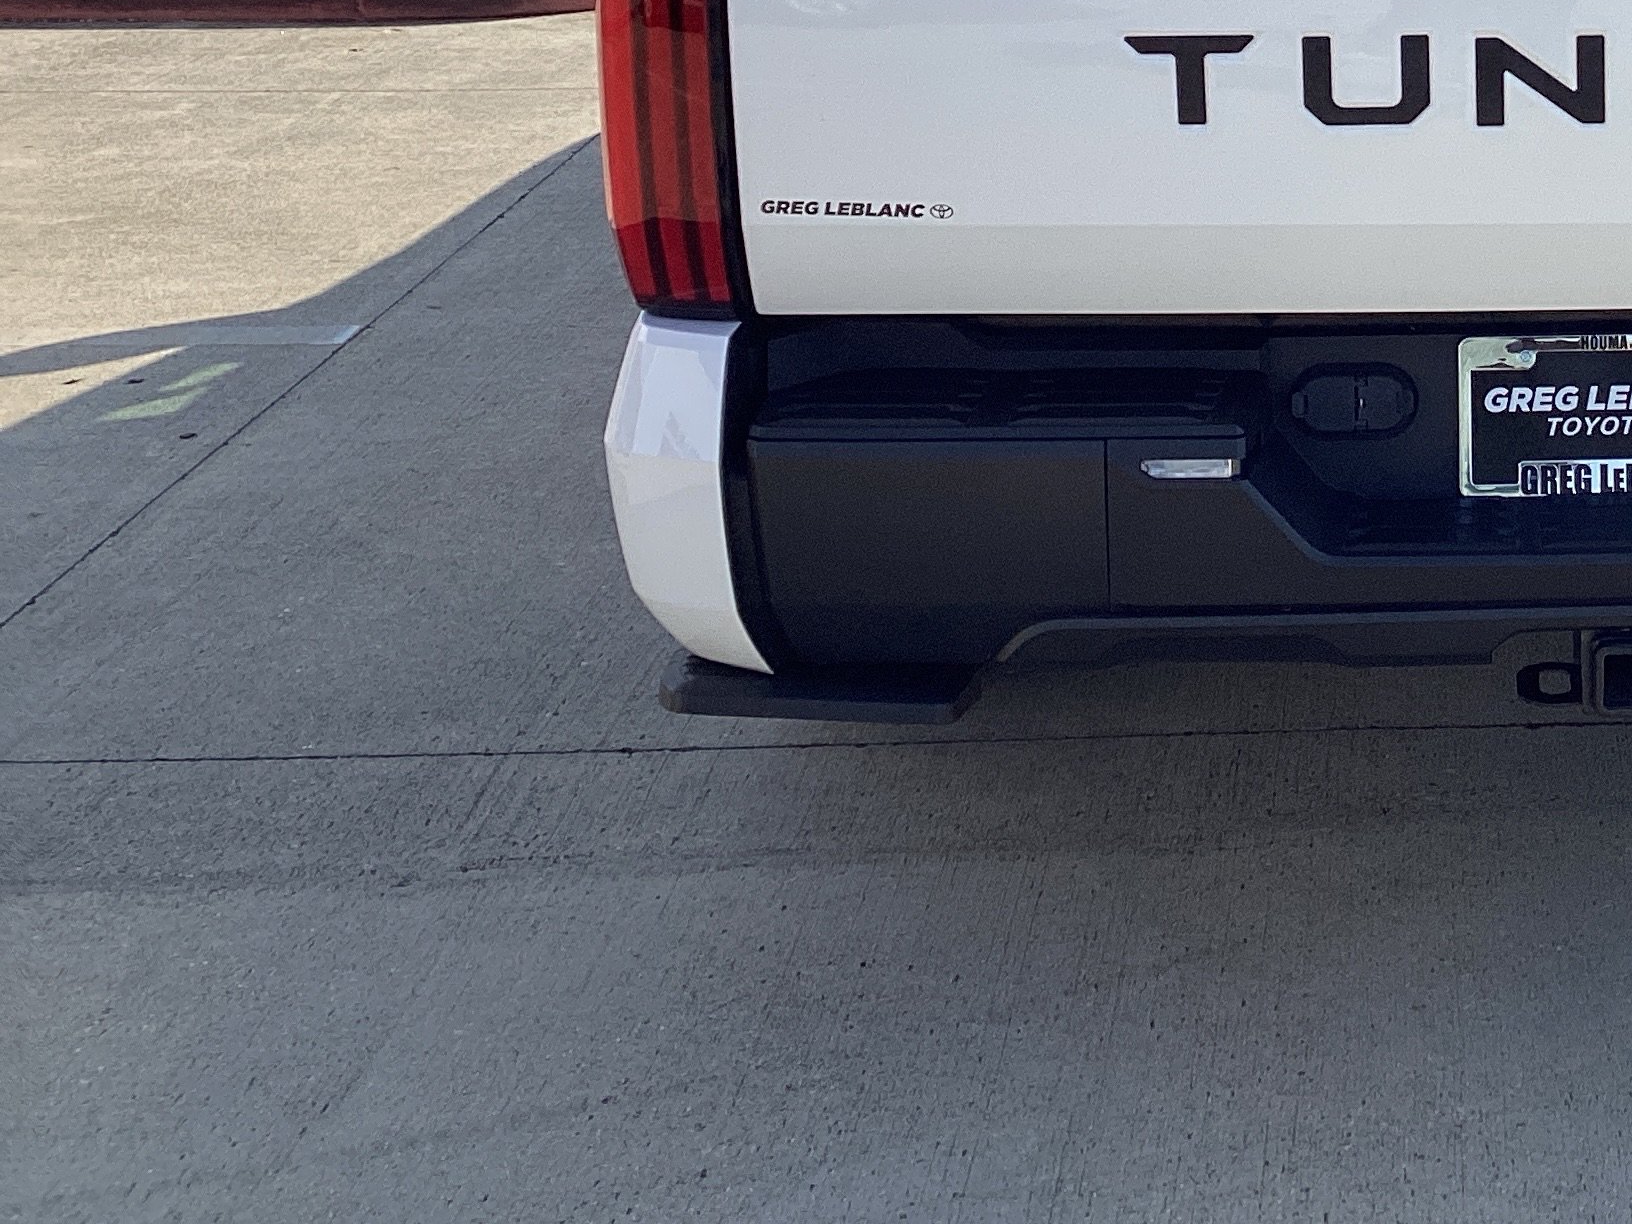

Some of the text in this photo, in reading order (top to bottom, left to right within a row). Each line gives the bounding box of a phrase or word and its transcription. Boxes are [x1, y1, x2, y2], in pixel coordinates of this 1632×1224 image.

[761, 200, 925, 218] GREG LEBLANC
[1484, 385, 1579, 413] GREG
[1520, 464, 1593, 496] GREG
